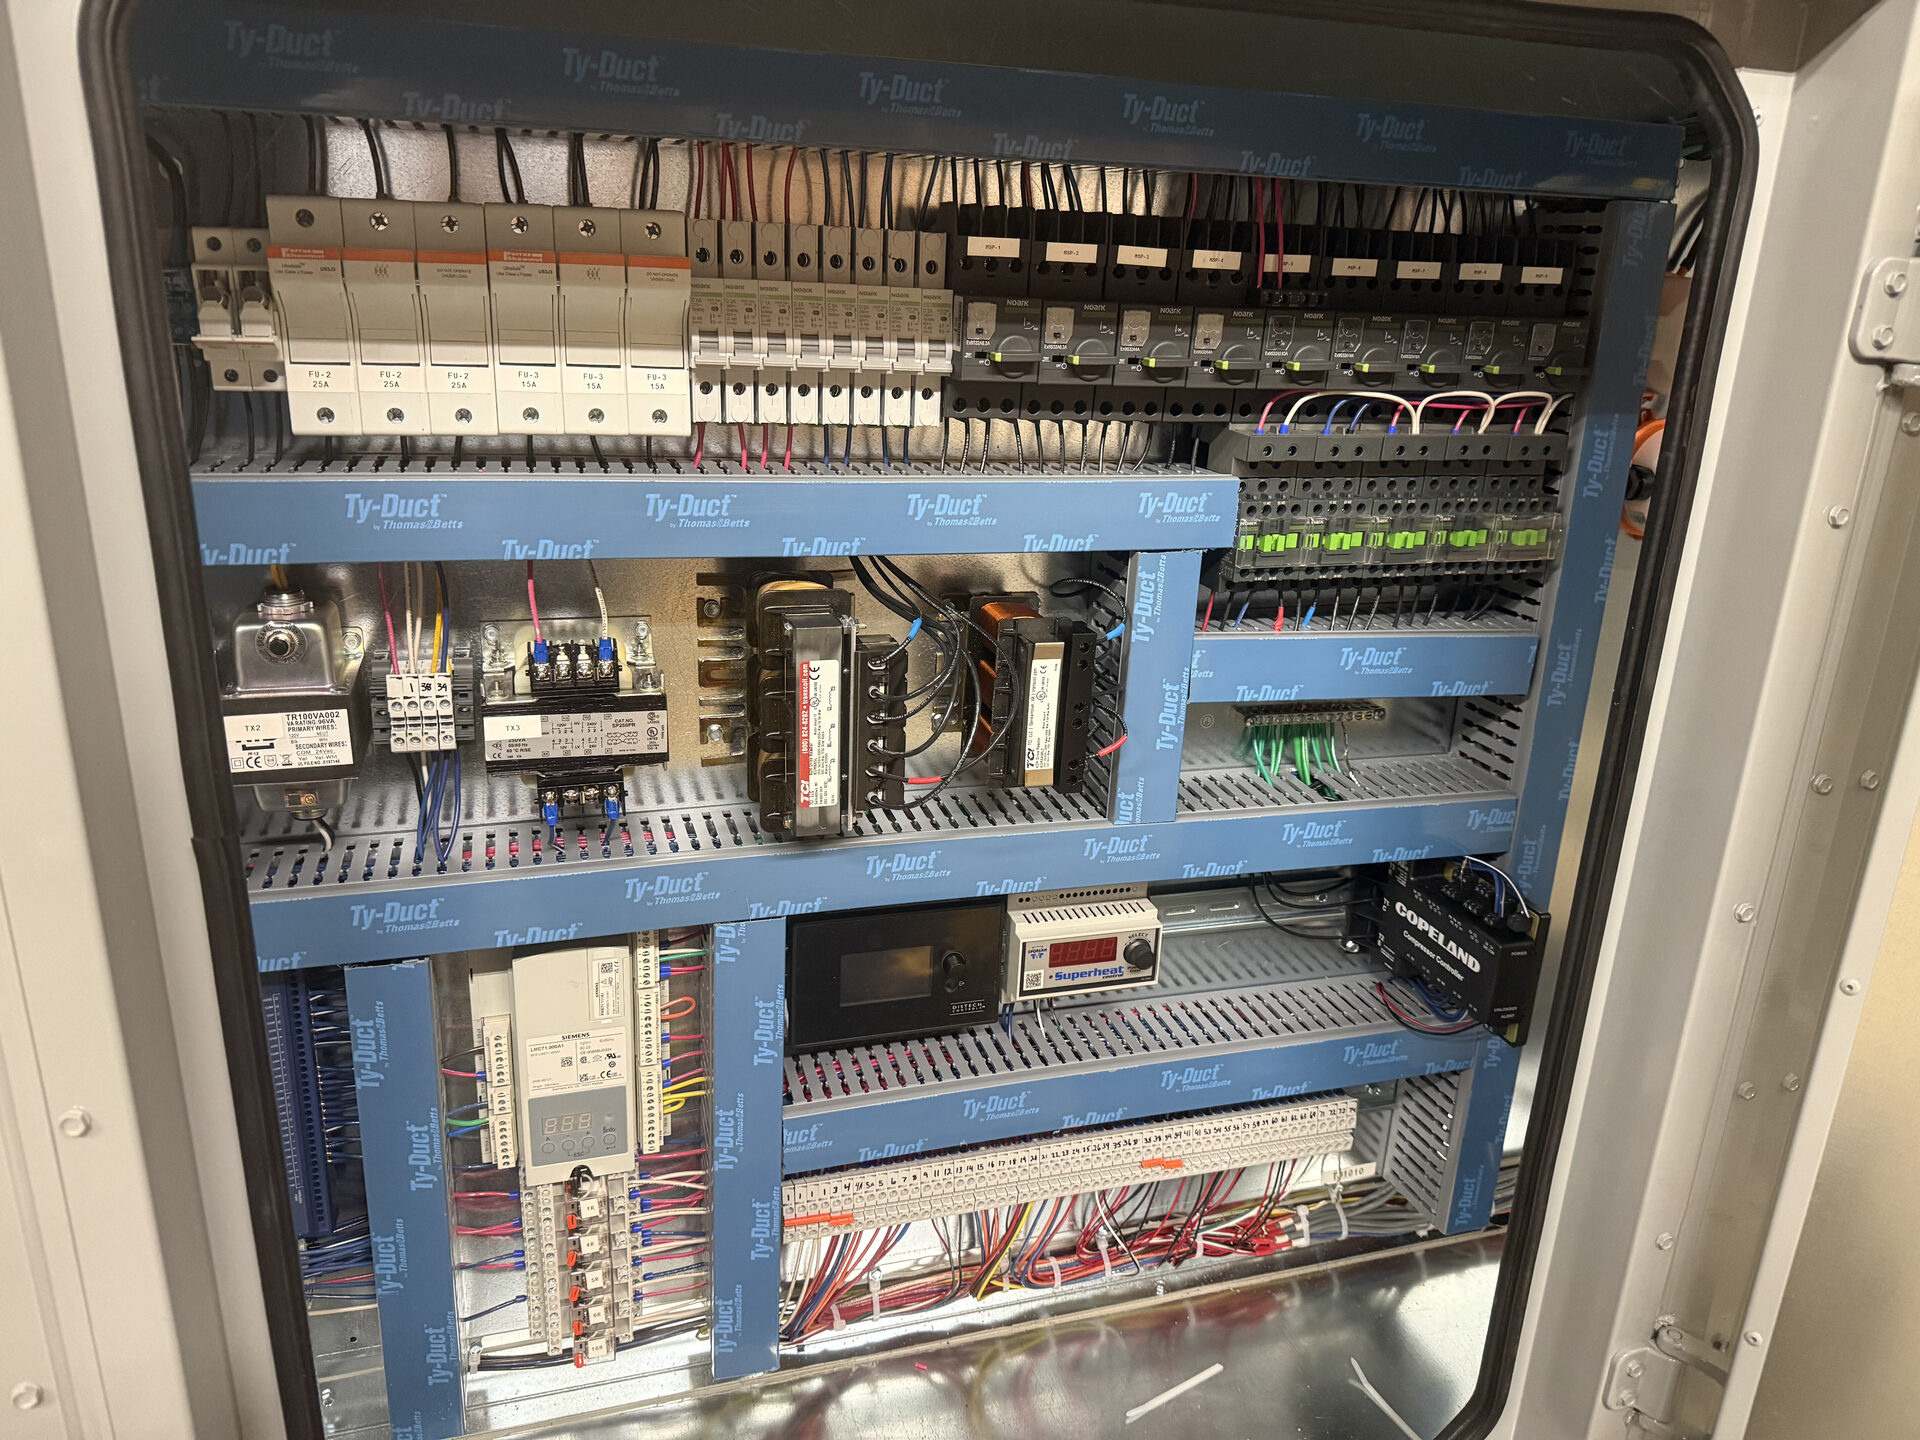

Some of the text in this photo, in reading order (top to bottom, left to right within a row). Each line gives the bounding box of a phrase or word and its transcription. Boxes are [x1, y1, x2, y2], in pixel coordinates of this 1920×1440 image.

[224, 20, 334, 58] Ty-Duct
[563, 46, 658, 82] Ty-Duct
[858, 71, 946, 104] Ty-Duct
[1123, 94, 1202, 124] Ty-Duct
[1357, 113, 1427, 141] Ty-Duct
[1563, 131, 1629, 157] Ty-Duct
[308, 370, 332, 378] FU-2
[312, 380, 330, 388] 25A
[379, 370, 402, 378] FU-2
[447, 371, 469, 380] FU-2
[450, 381, 467, 389] 25A
[518, 371, 539, 379] FU-3
[521, 381, 536, 389] 15A
[583, 372, 604, 380] FU-3
[586, 382, 602, 390] 15A
[646, 373, 667, 381] FU-3
[1582, 429, 1608, 498] Ty-Duct
[345, 493, 442, 524] Ty-Duct
[645, 493, 732, 522] Ty-Duct
[907, 493, 983, 521] Ty-Duct
[1138, 491, 1210, 518] Ty-Duct
[1131, 570, 1156, 643] Ty-Duct
[1340, 647, 1402, 670] Ty-Duct
[1546, 643, 1571, 706] Ty-Duct
[285, 711, 340, 720] TR100VA002
[505, 724, 521, 732] TX3
[1155, 682, 1180, 750] Ty-Duct
[295, 742, 327, 750] SECONDARY
[1282, 821, 1341, 845] Ty-Duct
[1467, 808, 1515, 831] Ty-Duc
[1084, 835, 1148, 860] Ty-Duct
[866, 851, 935, 878] Ty-Duct
[625, 873, 704, 903] Ty-Duct
[350, 899, 440, 930] Ty-Duct
[1394, 901, 1481, 973] COPELAND
[1403, 930, 1436, 961] Compressor
[1055, 966, 1125, 982] Superheat
[561, 1032, 590, 1040] SIEMENS
[753, 1001, 777, 1066] Ty-Duct
[352, 1019, 384, 1090] Ty-Duct
[1344, 1041, 1398, 1065] Ty-Duct
[1161, 1065, 1219, 1090] Ty-Duct
[963, 1092, 1026, 1119] Ty-Duct
[714, 1109, 739, 1171] Ty-Duct
[406, 1124, 437, 1191] Ty-Duct
[956, 1166, 963, 1174] 13
[1455, 1178, 1475, 1226] Ty-Duct
[751, 1202, 773, 1260] Ty-Duct
[373, 1235, 403, 1296] Ty-Duct
[714, 1299, 737, 1354] Ty-Duct
[424, 1327, 453, 1386] Ty-Duct
